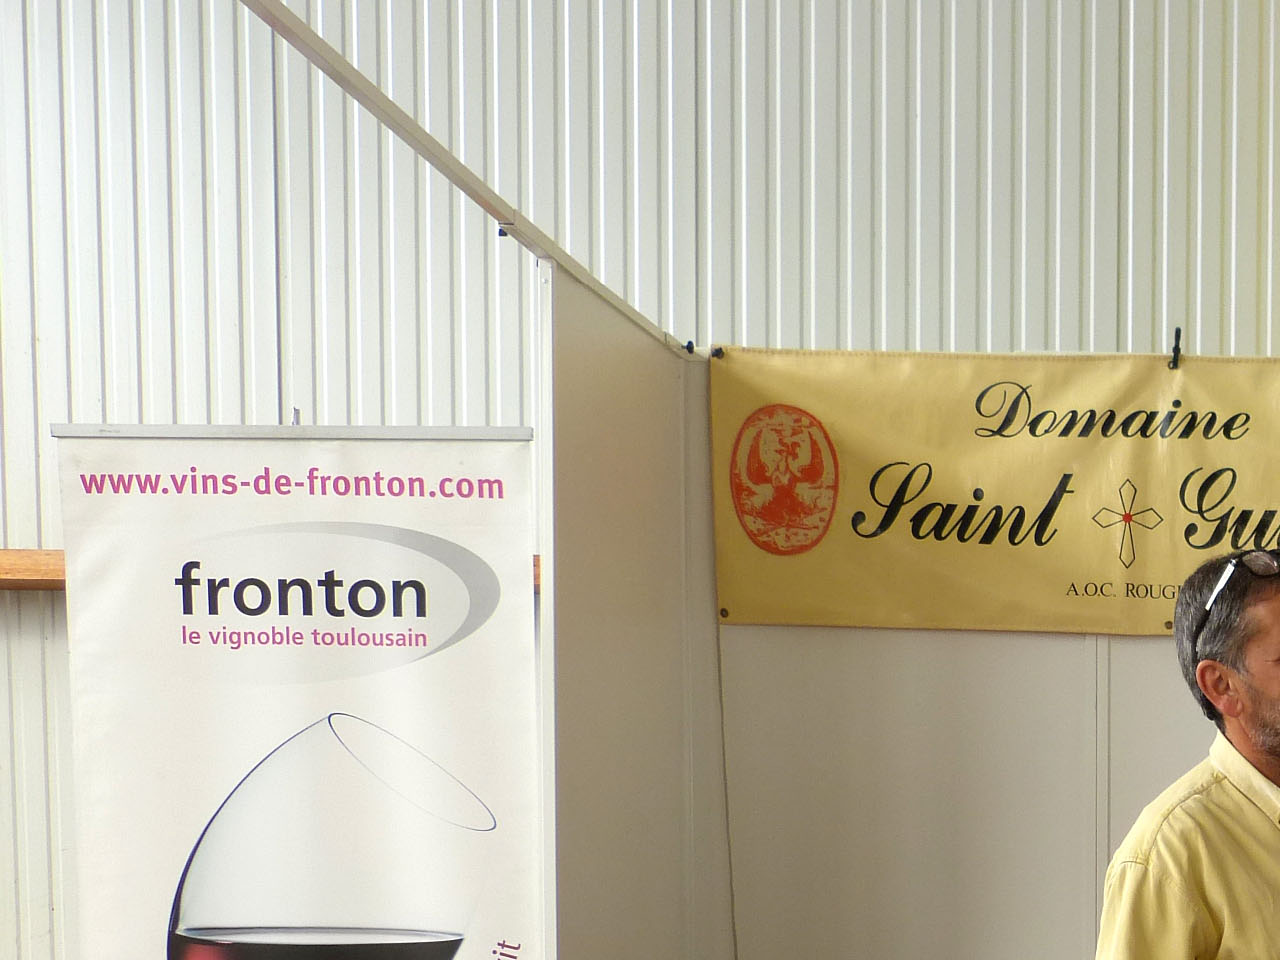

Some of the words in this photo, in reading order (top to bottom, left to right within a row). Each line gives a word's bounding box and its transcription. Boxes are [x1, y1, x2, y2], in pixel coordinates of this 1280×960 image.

[974, 381, 1250, 441] Domaine
[79, 467, 505, 500] www.vins-de-fronton.com
[851, 462, 1074, 548] Saint
[174, 560, 427, 617] fronton
[1065, 582, 1117, 598] A.O.C.
[182, 626, 200, 645] le
[209, 626, 304, 649] vignoble
[312, 627, 427, 647] toulousain
